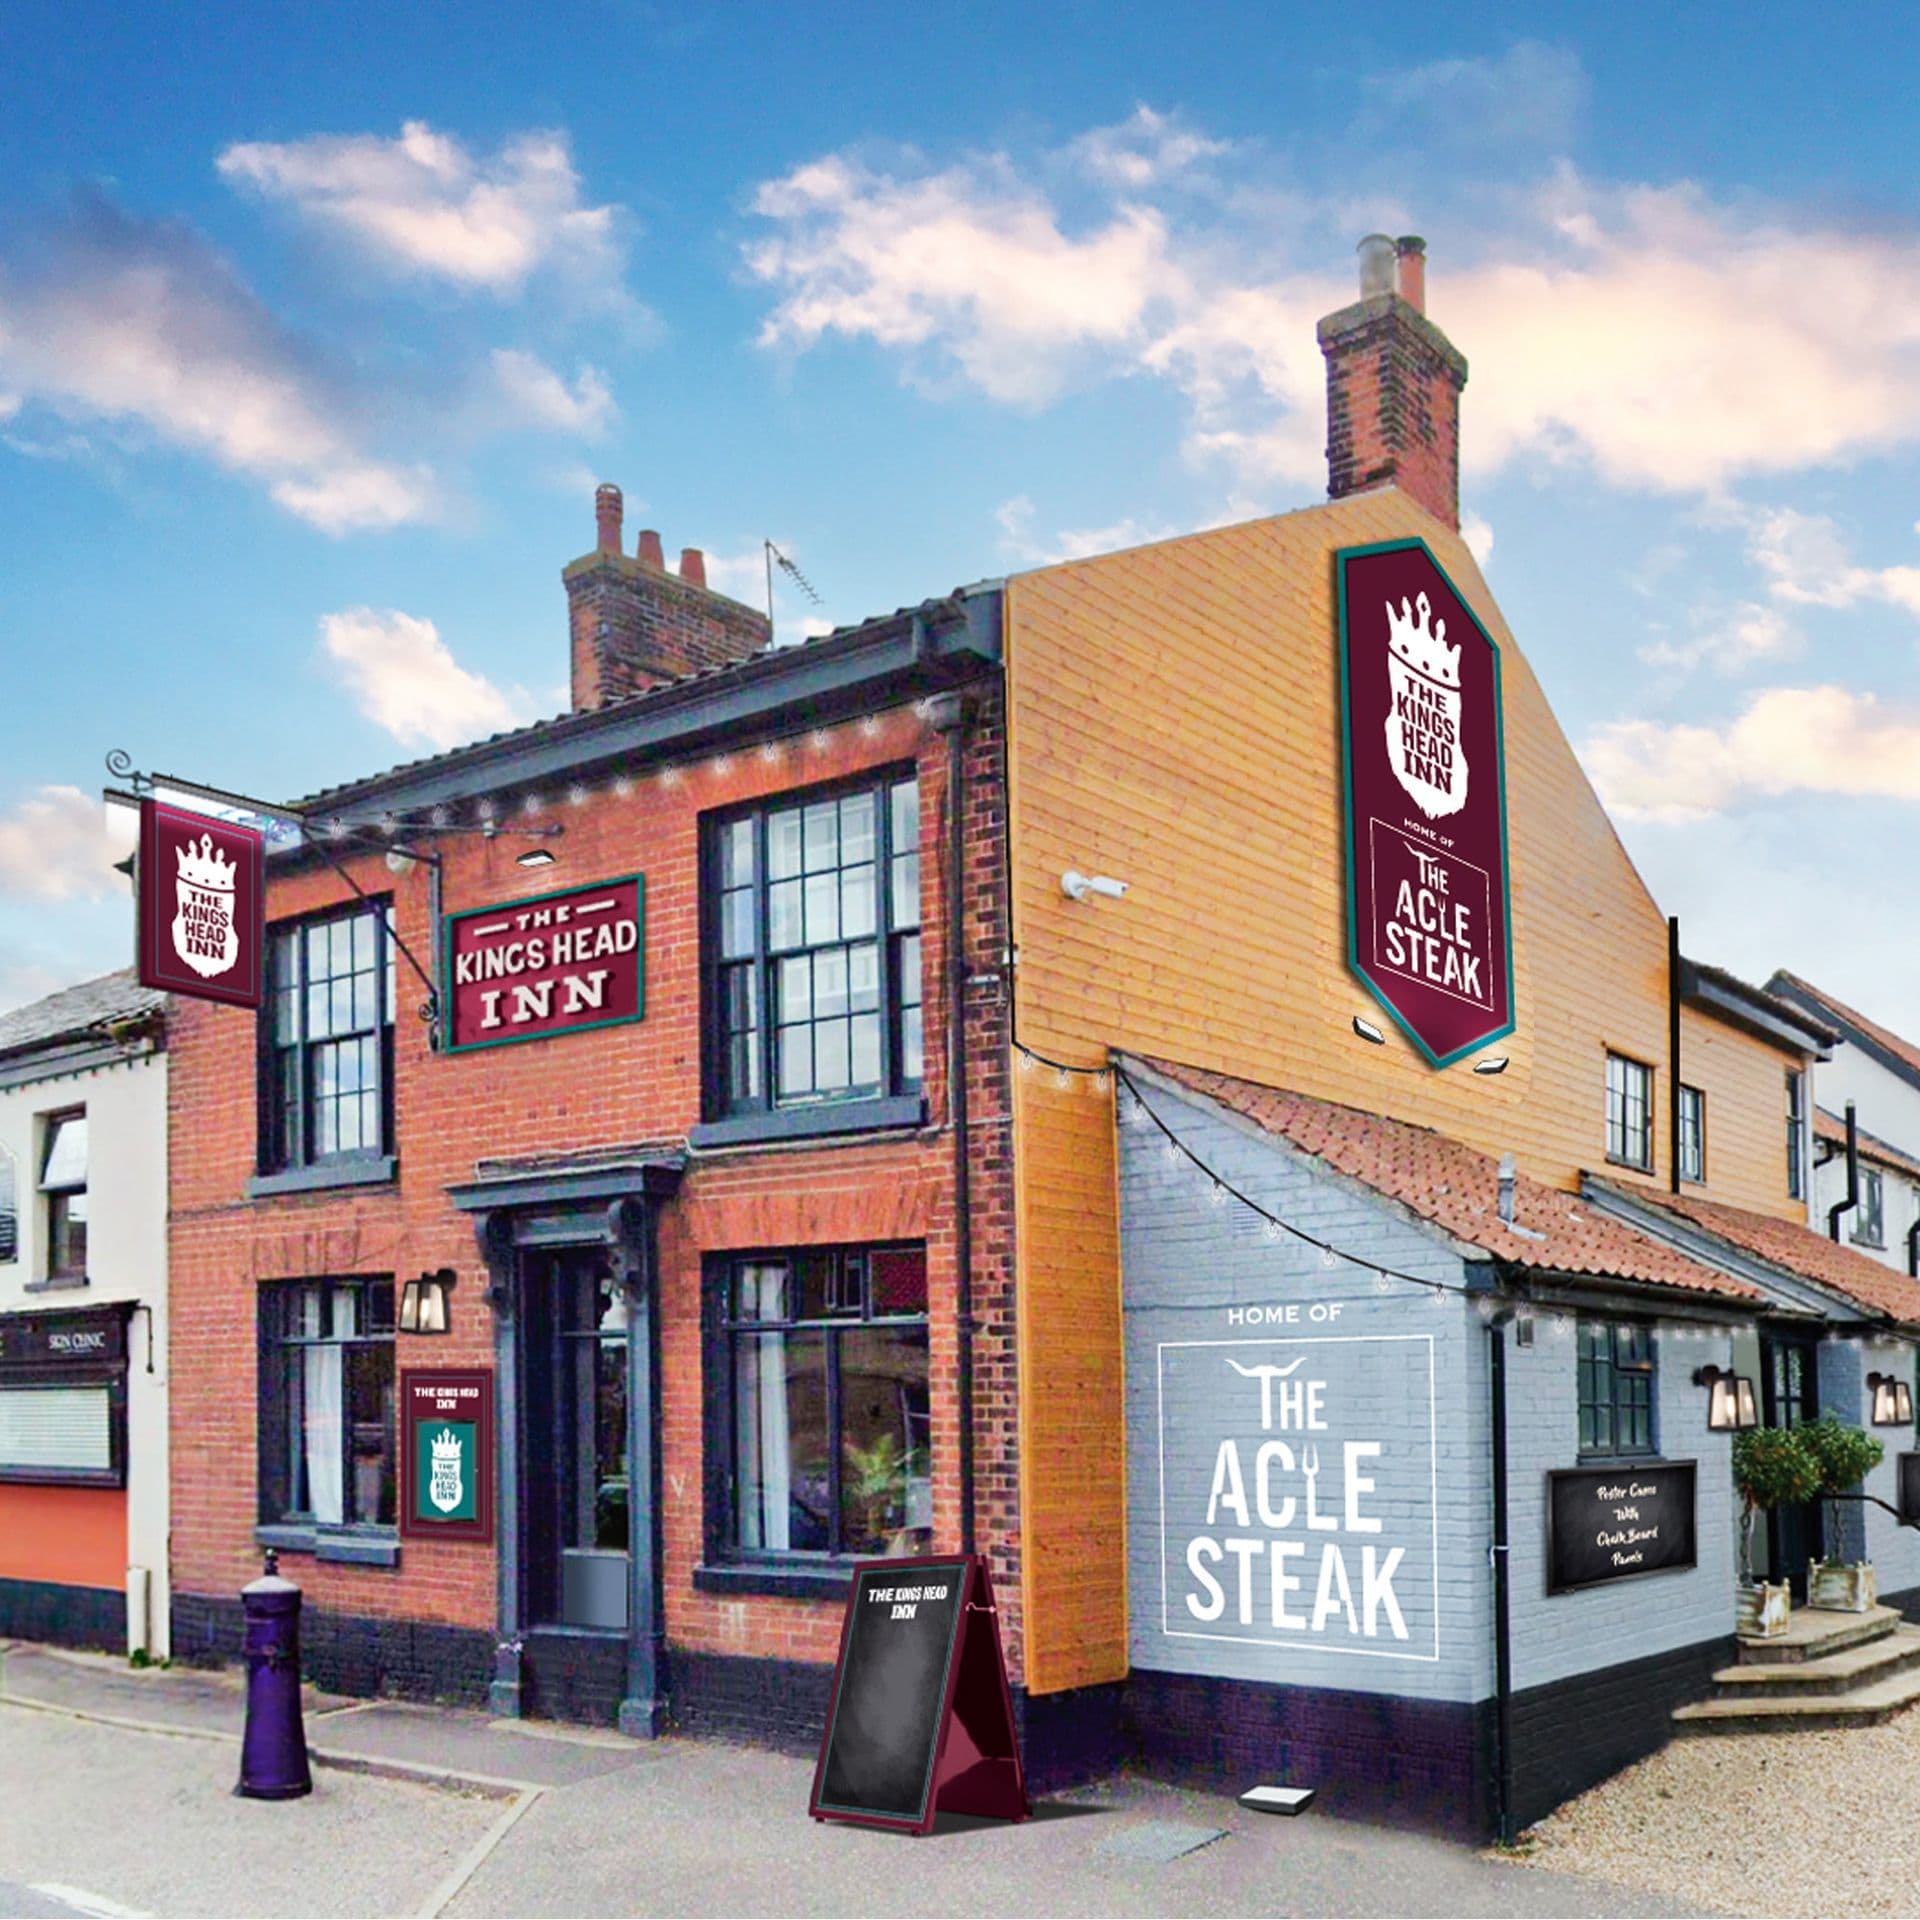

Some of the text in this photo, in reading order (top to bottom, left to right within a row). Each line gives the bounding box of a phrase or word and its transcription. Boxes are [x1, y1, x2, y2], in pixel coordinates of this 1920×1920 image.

[1404, 676, 1448, 714] THE
[1397, 691, 1456, 746] KINGS
[1401, 721, 1453, 770] HEAD
[1403, 749, 1453, 795] INN
[1403, 817, 1455, 849] HOME OF
[1403, 841, 1450, 895] THE
[182, 902, 229, 928] KINGS
[189, 890, 223, 909] THE
[516, 905, 571, 931] THE
[1395, 879, 1472, 949] ACLE
[185, 921, 226, 944] HEAD
[185, 937, 226, 960] INN
[456, 920, 638, 985] KINGS HEAD
[1385, 921, 1483, 999] STEAK
[480, 969, 608, 1029] INN
[1228, 1303, 1344, 1326] HOME OF
[414, 1387, 436, 1398] THE
[1224, 1357, 1329, 1431] THE
[1206, 1440, 1383, 1533] ACLE
[868, 1588, 895, 1602] THE
[1185, 1536, 1410, 1640] STEAK
[891, 1603, 917, 1620] INN
